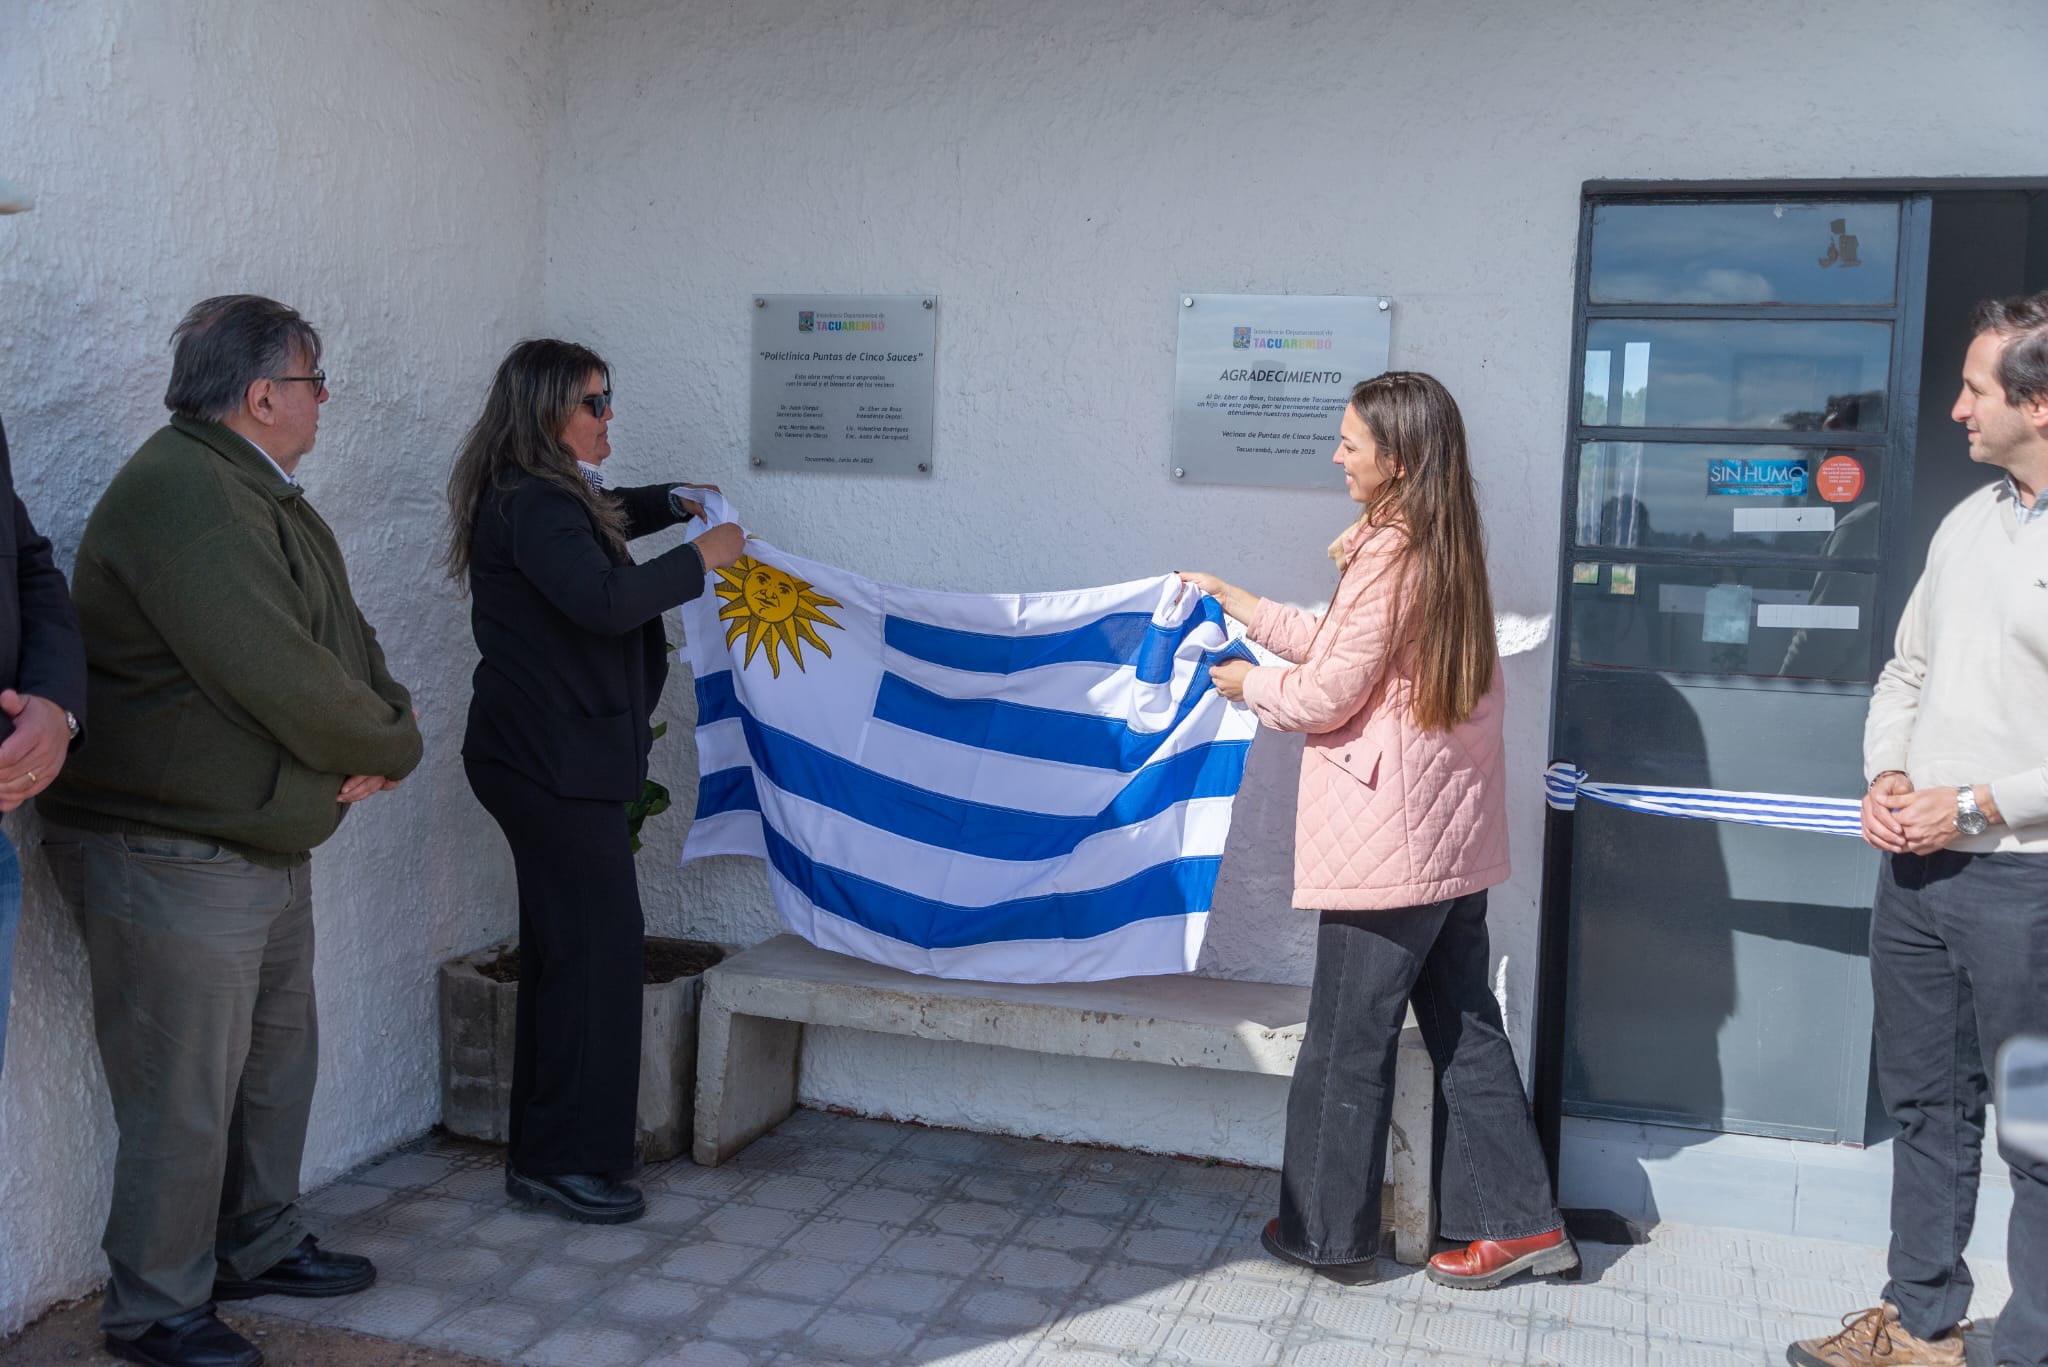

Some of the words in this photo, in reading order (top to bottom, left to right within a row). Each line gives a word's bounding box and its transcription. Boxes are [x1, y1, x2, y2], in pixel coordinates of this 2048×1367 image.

[816, 320, 885, 331] TACUAREMBÓ
[1254, 338, 1332, 349] TACUAREMBÓ
[812, 352, 843, 361] Puntas
[845, 352, 857, 361] de
[859, 352, 884, 362] Cinco
[1220, 369, 1342, 384] AGRADECIMIENTO
[1236, 446, 1273, 454] Tacuarembó,
[1710, 466, 1741, 482] SIN
[1744, 466, 1803, 482] HUMO
